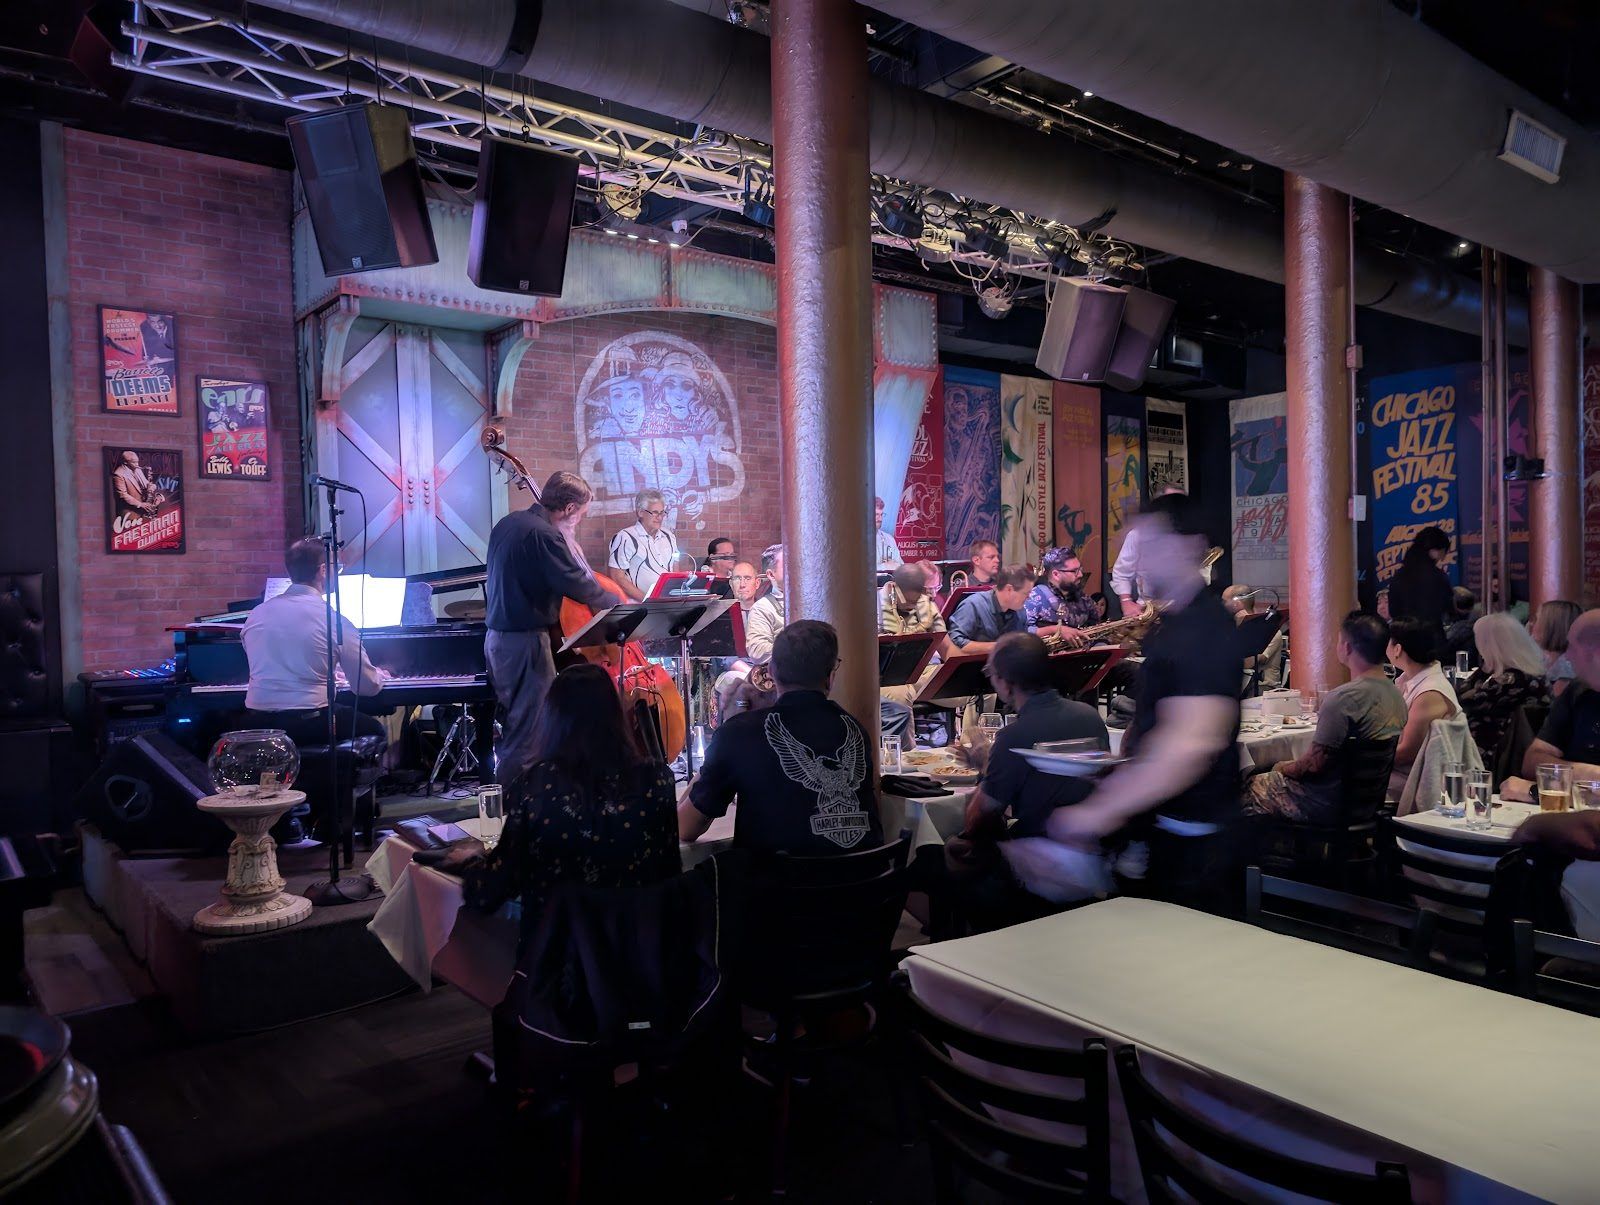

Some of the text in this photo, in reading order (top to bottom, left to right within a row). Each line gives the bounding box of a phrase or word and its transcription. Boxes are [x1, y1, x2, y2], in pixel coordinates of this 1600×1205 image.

[110, 376, 173, 398] DEEMS
[1371, 385, 1456, 428] CHICAGO
[205, 432, 265, 447] JAZZ
[1037, 421, 1047, 461] FESTIVAL
[1386, 412, 1456, 459] JAZZ
[207, 463, 232, 475] LEWIS
[241, 464, 266, 475] TOUFF
[1037, 463, 1046, 483] JAZZ
[1372, 452, 1457, 500] FESTIVAL
[1037, 484, 1047, 511] STYLE
[1236, 496, 1289, 506] CHICAGO
[1410, 482, 1450, 514] 85
[114, 510, 178, 549] FREEMAN
[1037, 513, 1046, 530] OLD
[137, 523, 180, 549] QUINTET
[827, 804, 853, 814] MOTOR
[832, 829, 860, 844] CYCLES
